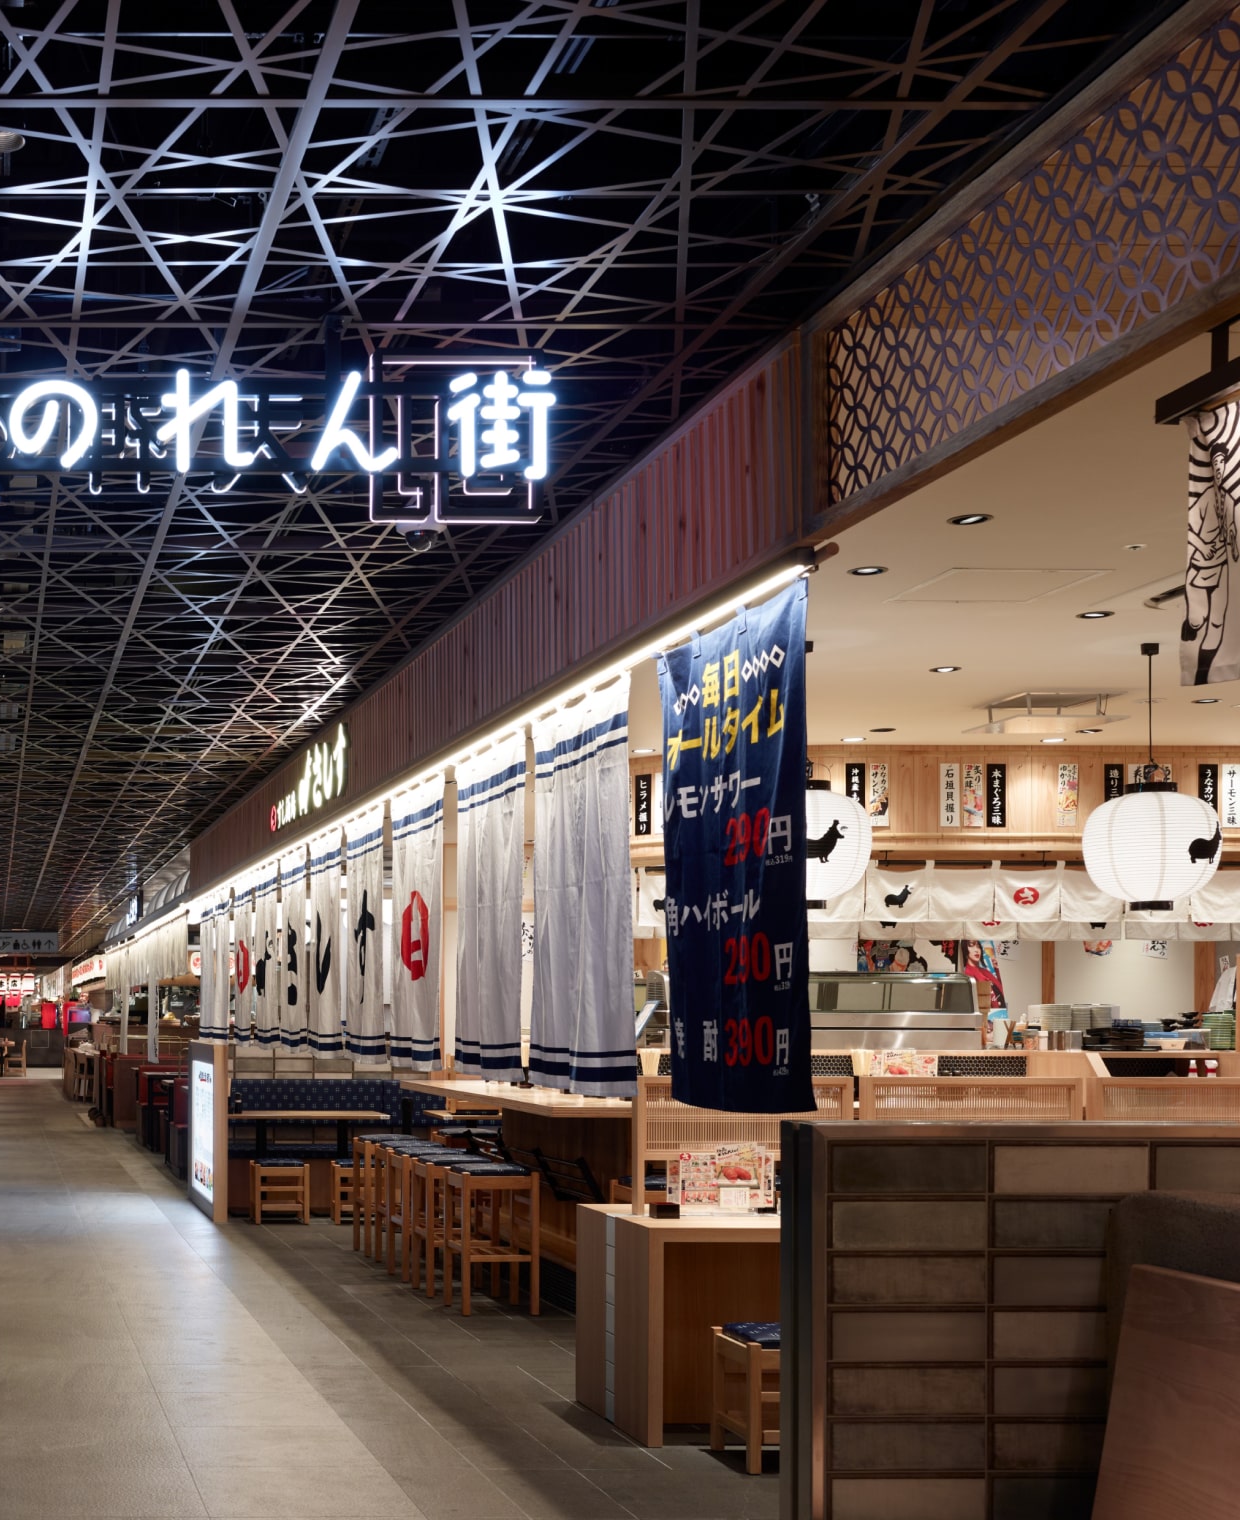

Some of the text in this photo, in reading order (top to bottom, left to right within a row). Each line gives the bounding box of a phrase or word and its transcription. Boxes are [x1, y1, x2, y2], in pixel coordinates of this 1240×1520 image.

[702, 649, 740, 708] 毎日
[667, 688, 785, 771] オールタイム
[664, 769, 761, 823] レモンサワー
[1109, 768, 1119, 800] 造り三
[666, 889, 761, 937] 角ハイボール
